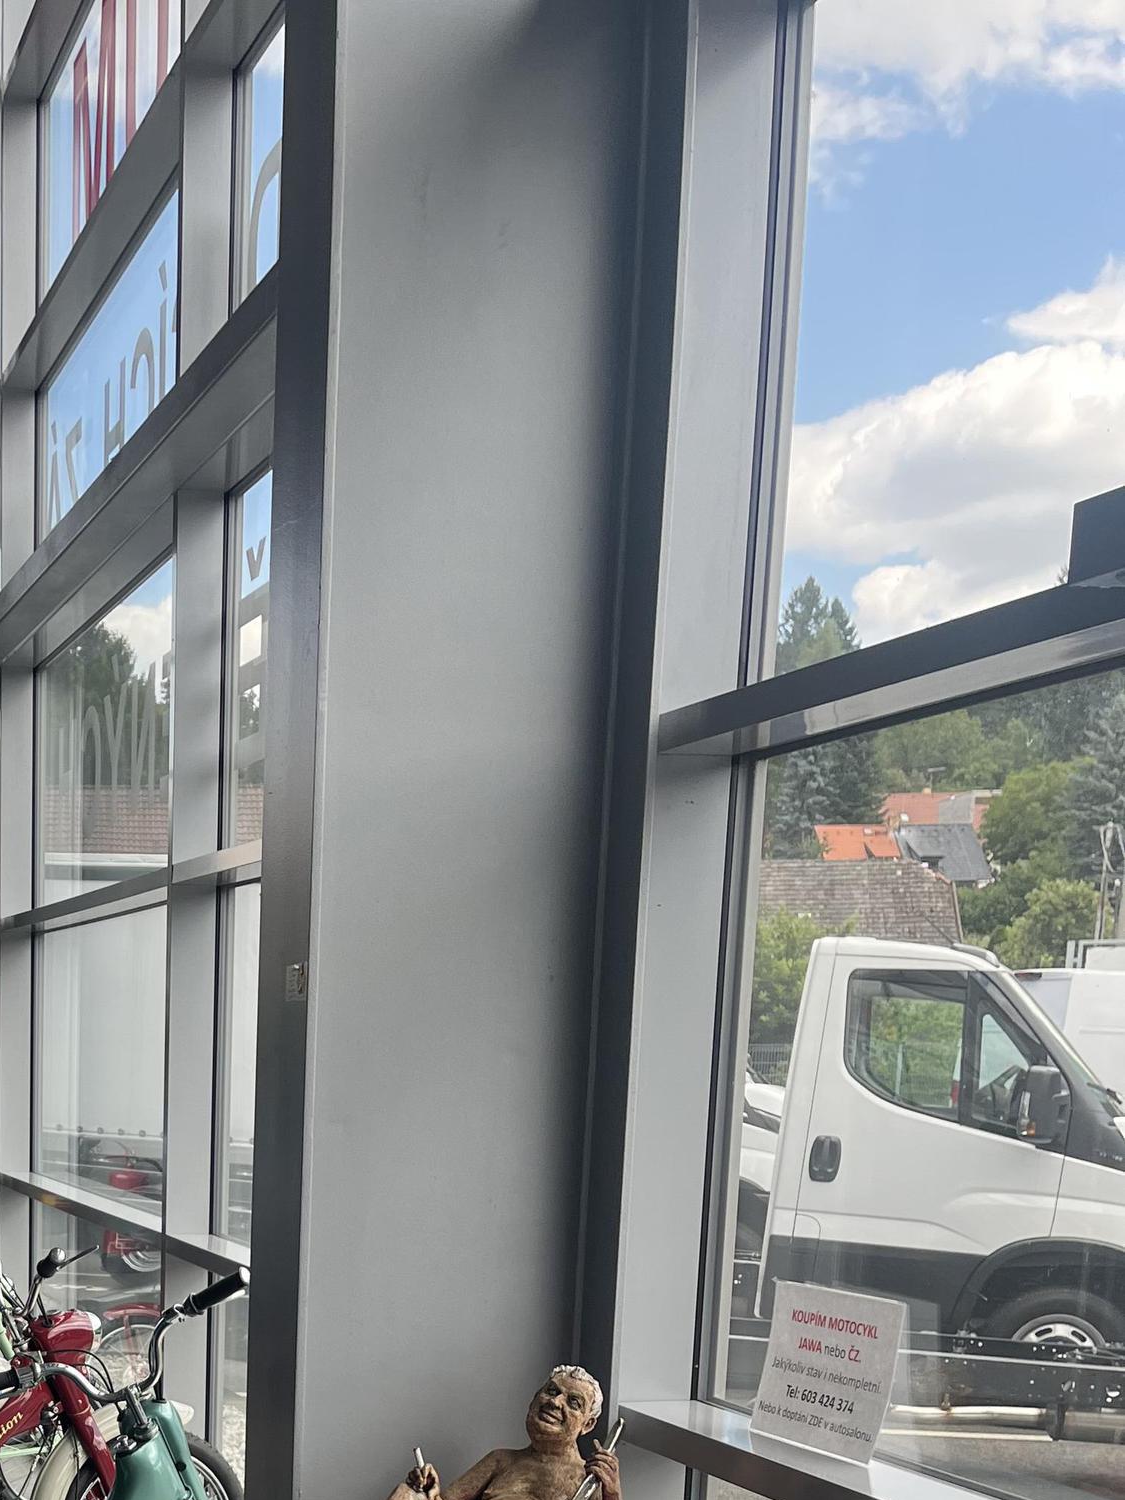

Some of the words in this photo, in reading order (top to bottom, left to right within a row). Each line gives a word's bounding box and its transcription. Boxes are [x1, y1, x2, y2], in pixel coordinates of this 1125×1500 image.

[791, 1309, 826, 1328] KOUPÍM
[828, 1317, 878, 1339] MOTOCYKL
[798, 1337, 822, 1354] JAWA
[824, 1343, 846, 1359] nebo
[848, 1345, 862, 1363] ČZ.
[806, 1366, 823, 1379] stav
[828, 1371, 882, 1394] nekompletní.
[786, 1384, 800, 1399] Tel:
[801, 1389, 818, 1404] 603
[818, 1394, 836, 1409] 424
[836, 1398, 855, 1415] 374
[758, 1400, 776, 1414] Nebo
[808, 1414, 824, 1428] ZDE
[829, 1422, 873, 1443] autosalonu.
